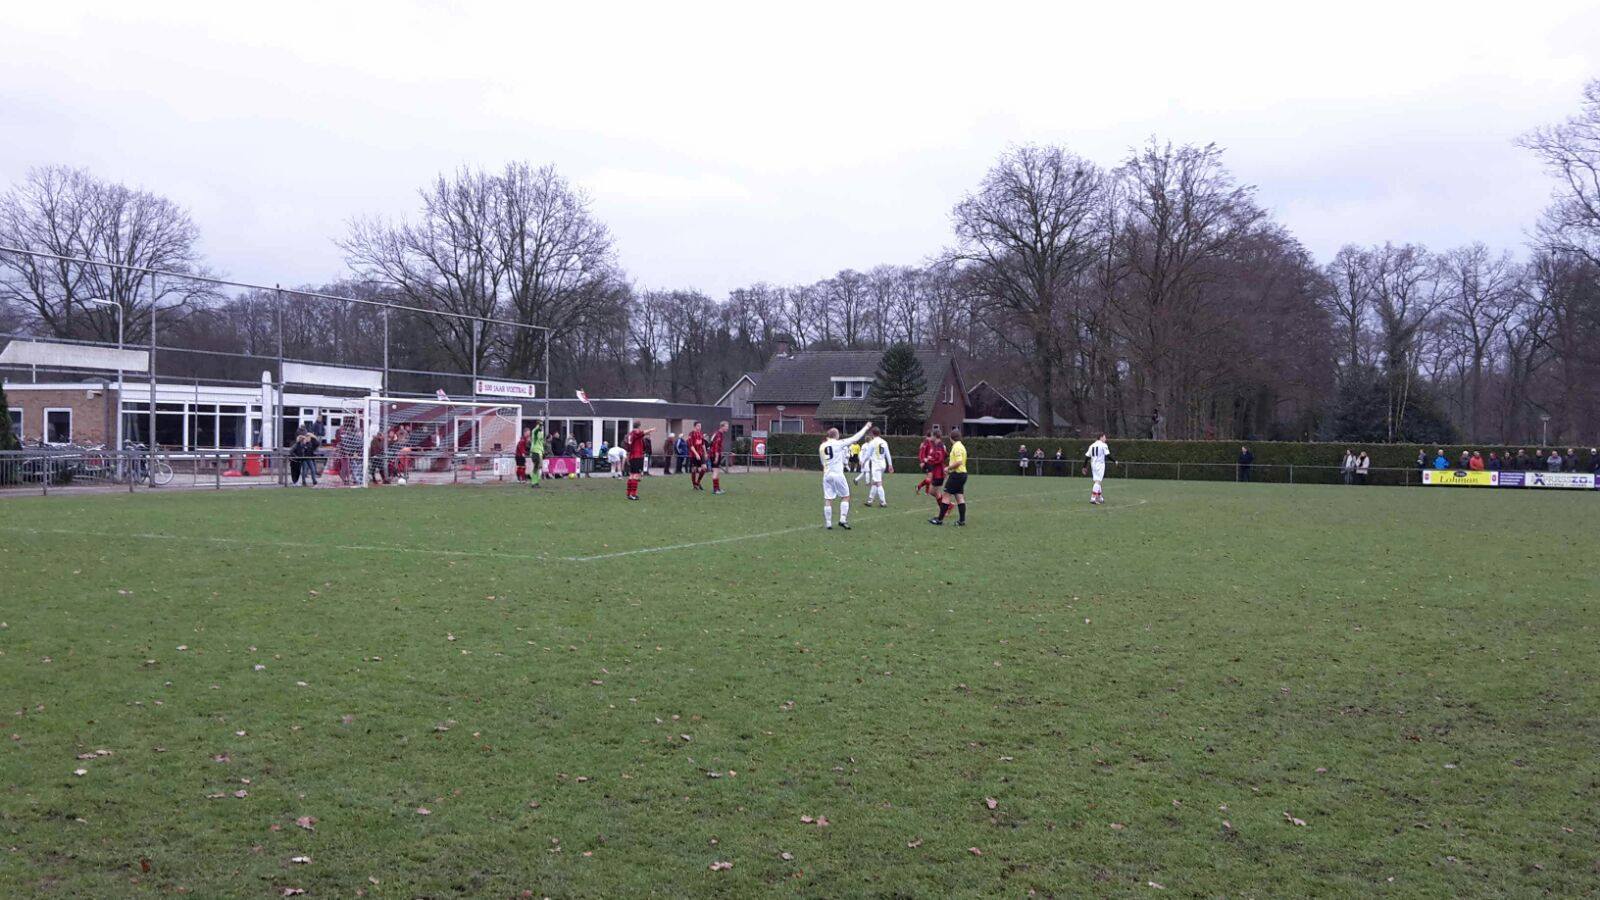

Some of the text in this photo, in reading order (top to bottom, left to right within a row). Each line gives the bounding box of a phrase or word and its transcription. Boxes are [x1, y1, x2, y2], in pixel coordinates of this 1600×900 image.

[493, 385, 505, 393] JAAR
[824, 445, 834, 460] 9
[1091, 446, 1099, 457] 11
